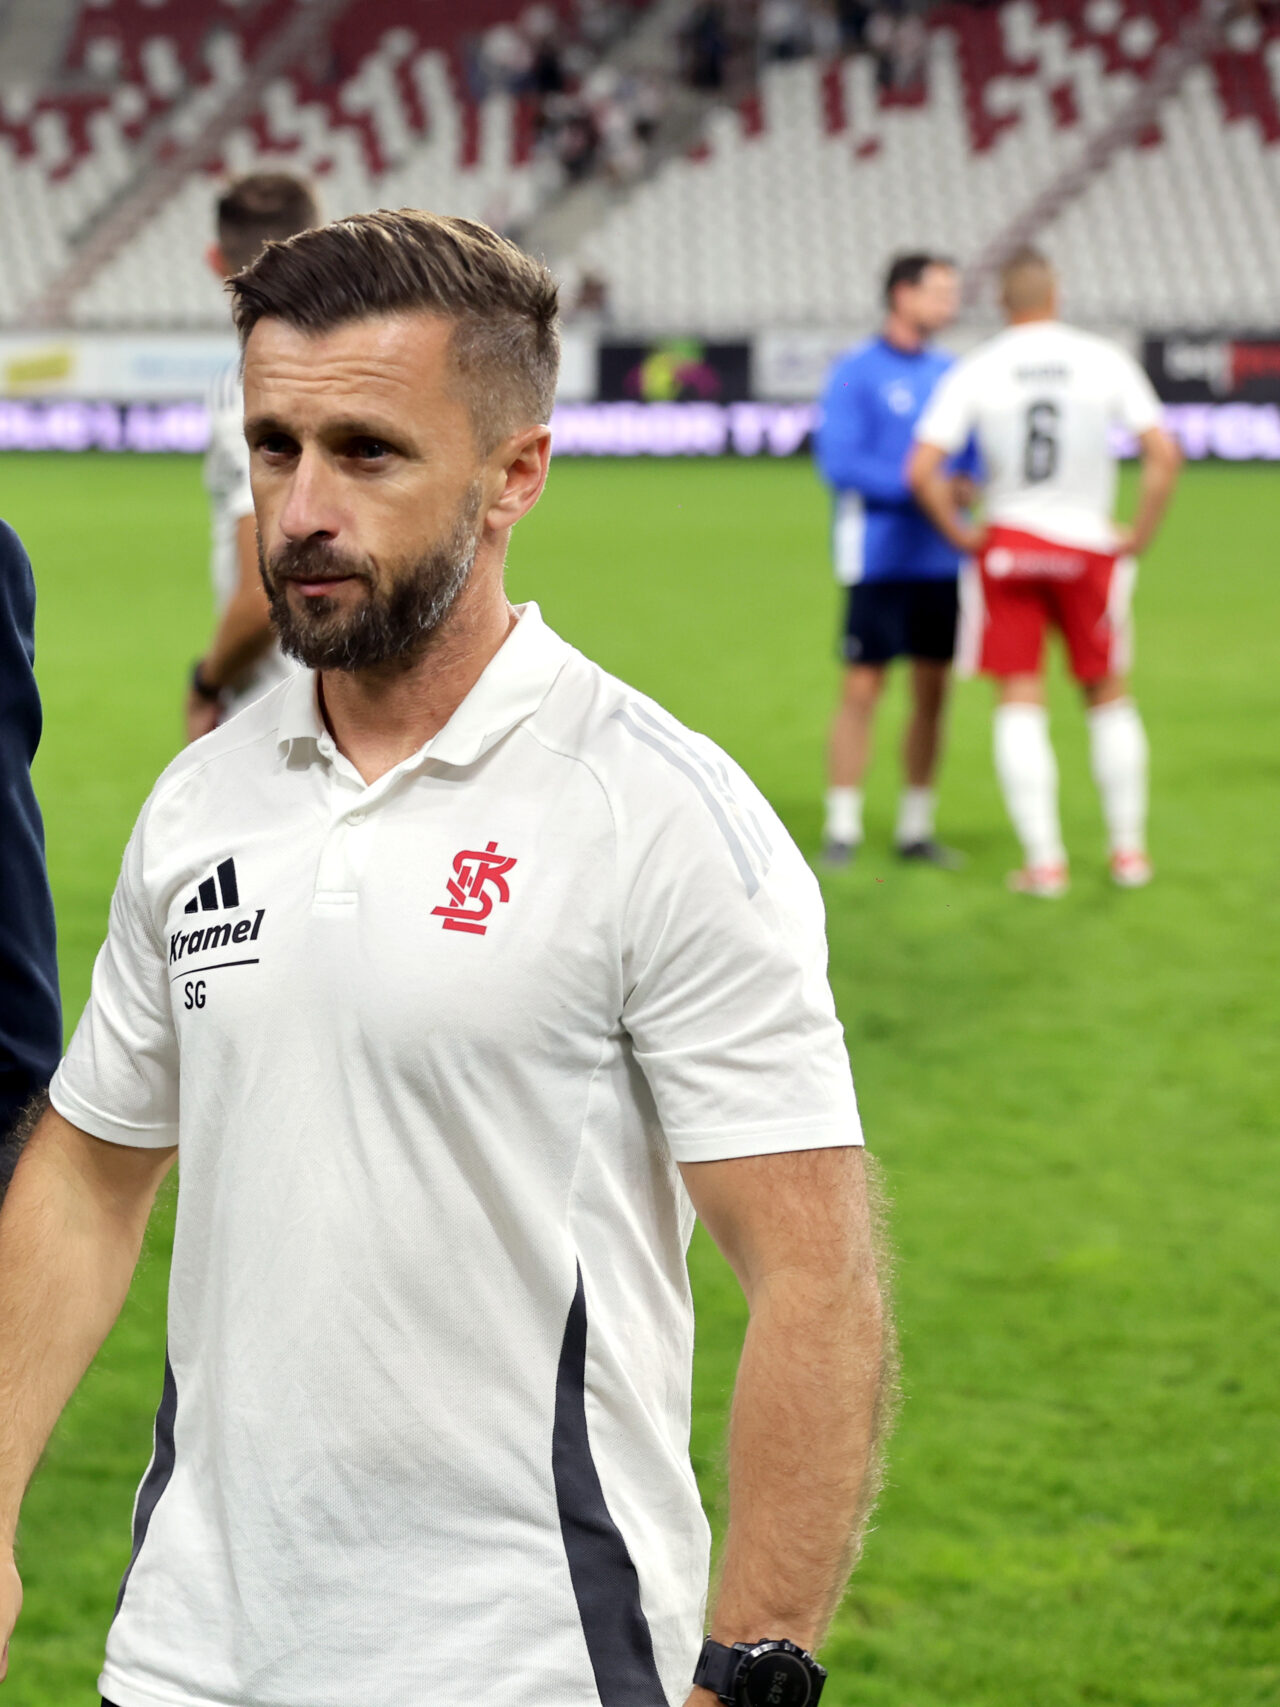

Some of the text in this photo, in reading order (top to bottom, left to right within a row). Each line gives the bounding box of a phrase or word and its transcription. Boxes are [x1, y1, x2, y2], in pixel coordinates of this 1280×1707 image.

[1024, 399, 1058, 482] 6
[169, 908, 265, 964] Kramel
[184, 980, 207, 1010] SG
